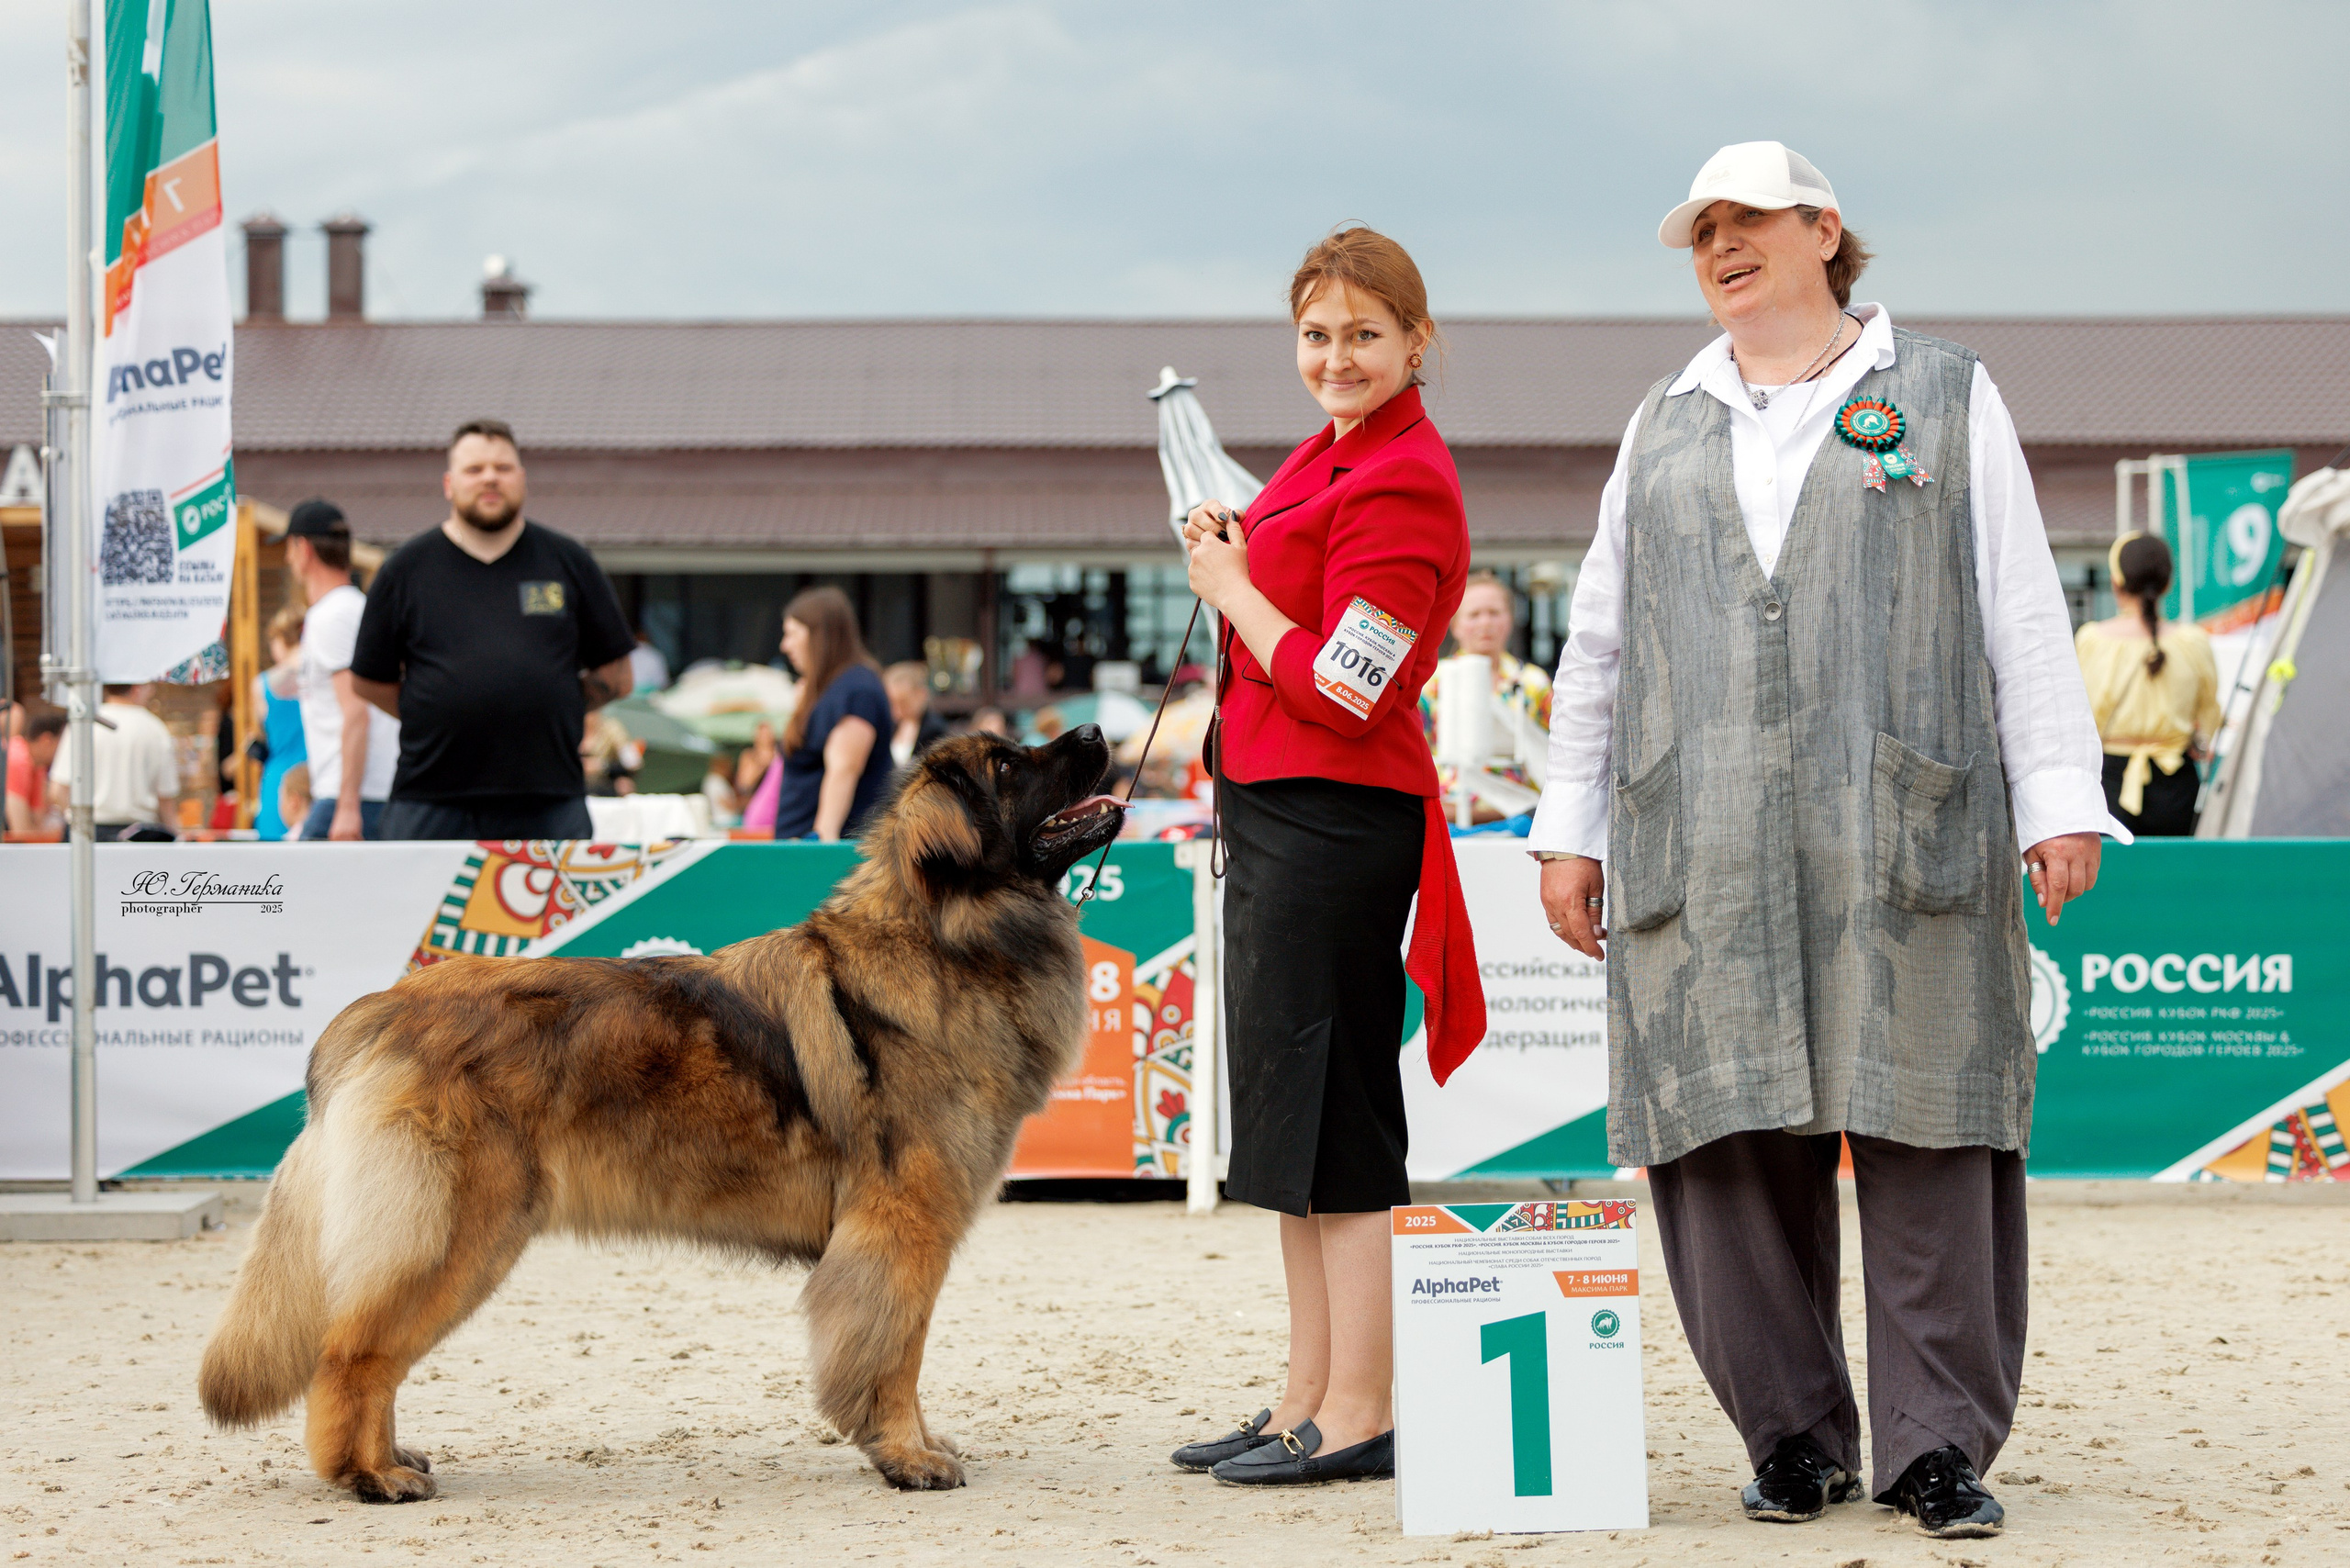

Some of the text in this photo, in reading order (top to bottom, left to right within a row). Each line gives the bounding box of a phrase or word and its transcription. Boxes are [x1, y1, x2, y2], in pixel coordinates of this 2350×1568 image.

[2227, 502, 2272, 587] 9
[1370, 626, 1395, 645] РОССИЯ
[1330, 641, 1386, 687] 1016
[1336, 686, 1370, 711] 8.06.2025
[1479, 957, 1606, 979] ссийская
[2081, 953, 2293, 994] РОССИЯ
[1486, 996, 1607, 1014] нологиче
[201, 1028, 304, 1049] РАЦИОНЫ
[1483, 1030, 1603, 1054] дерация
[1404, 1215, 1437, 1227] 2025
[1567, 1275, 1574, 1284] 7
[1583, 1274, 1590, 1284] 8
[1592, 1273, 1628, 1284] ИЮНЯ
[1589, 1341, 1625, 1350] РОССИЯ
[1480, 1310, 1553, 1497] 1
